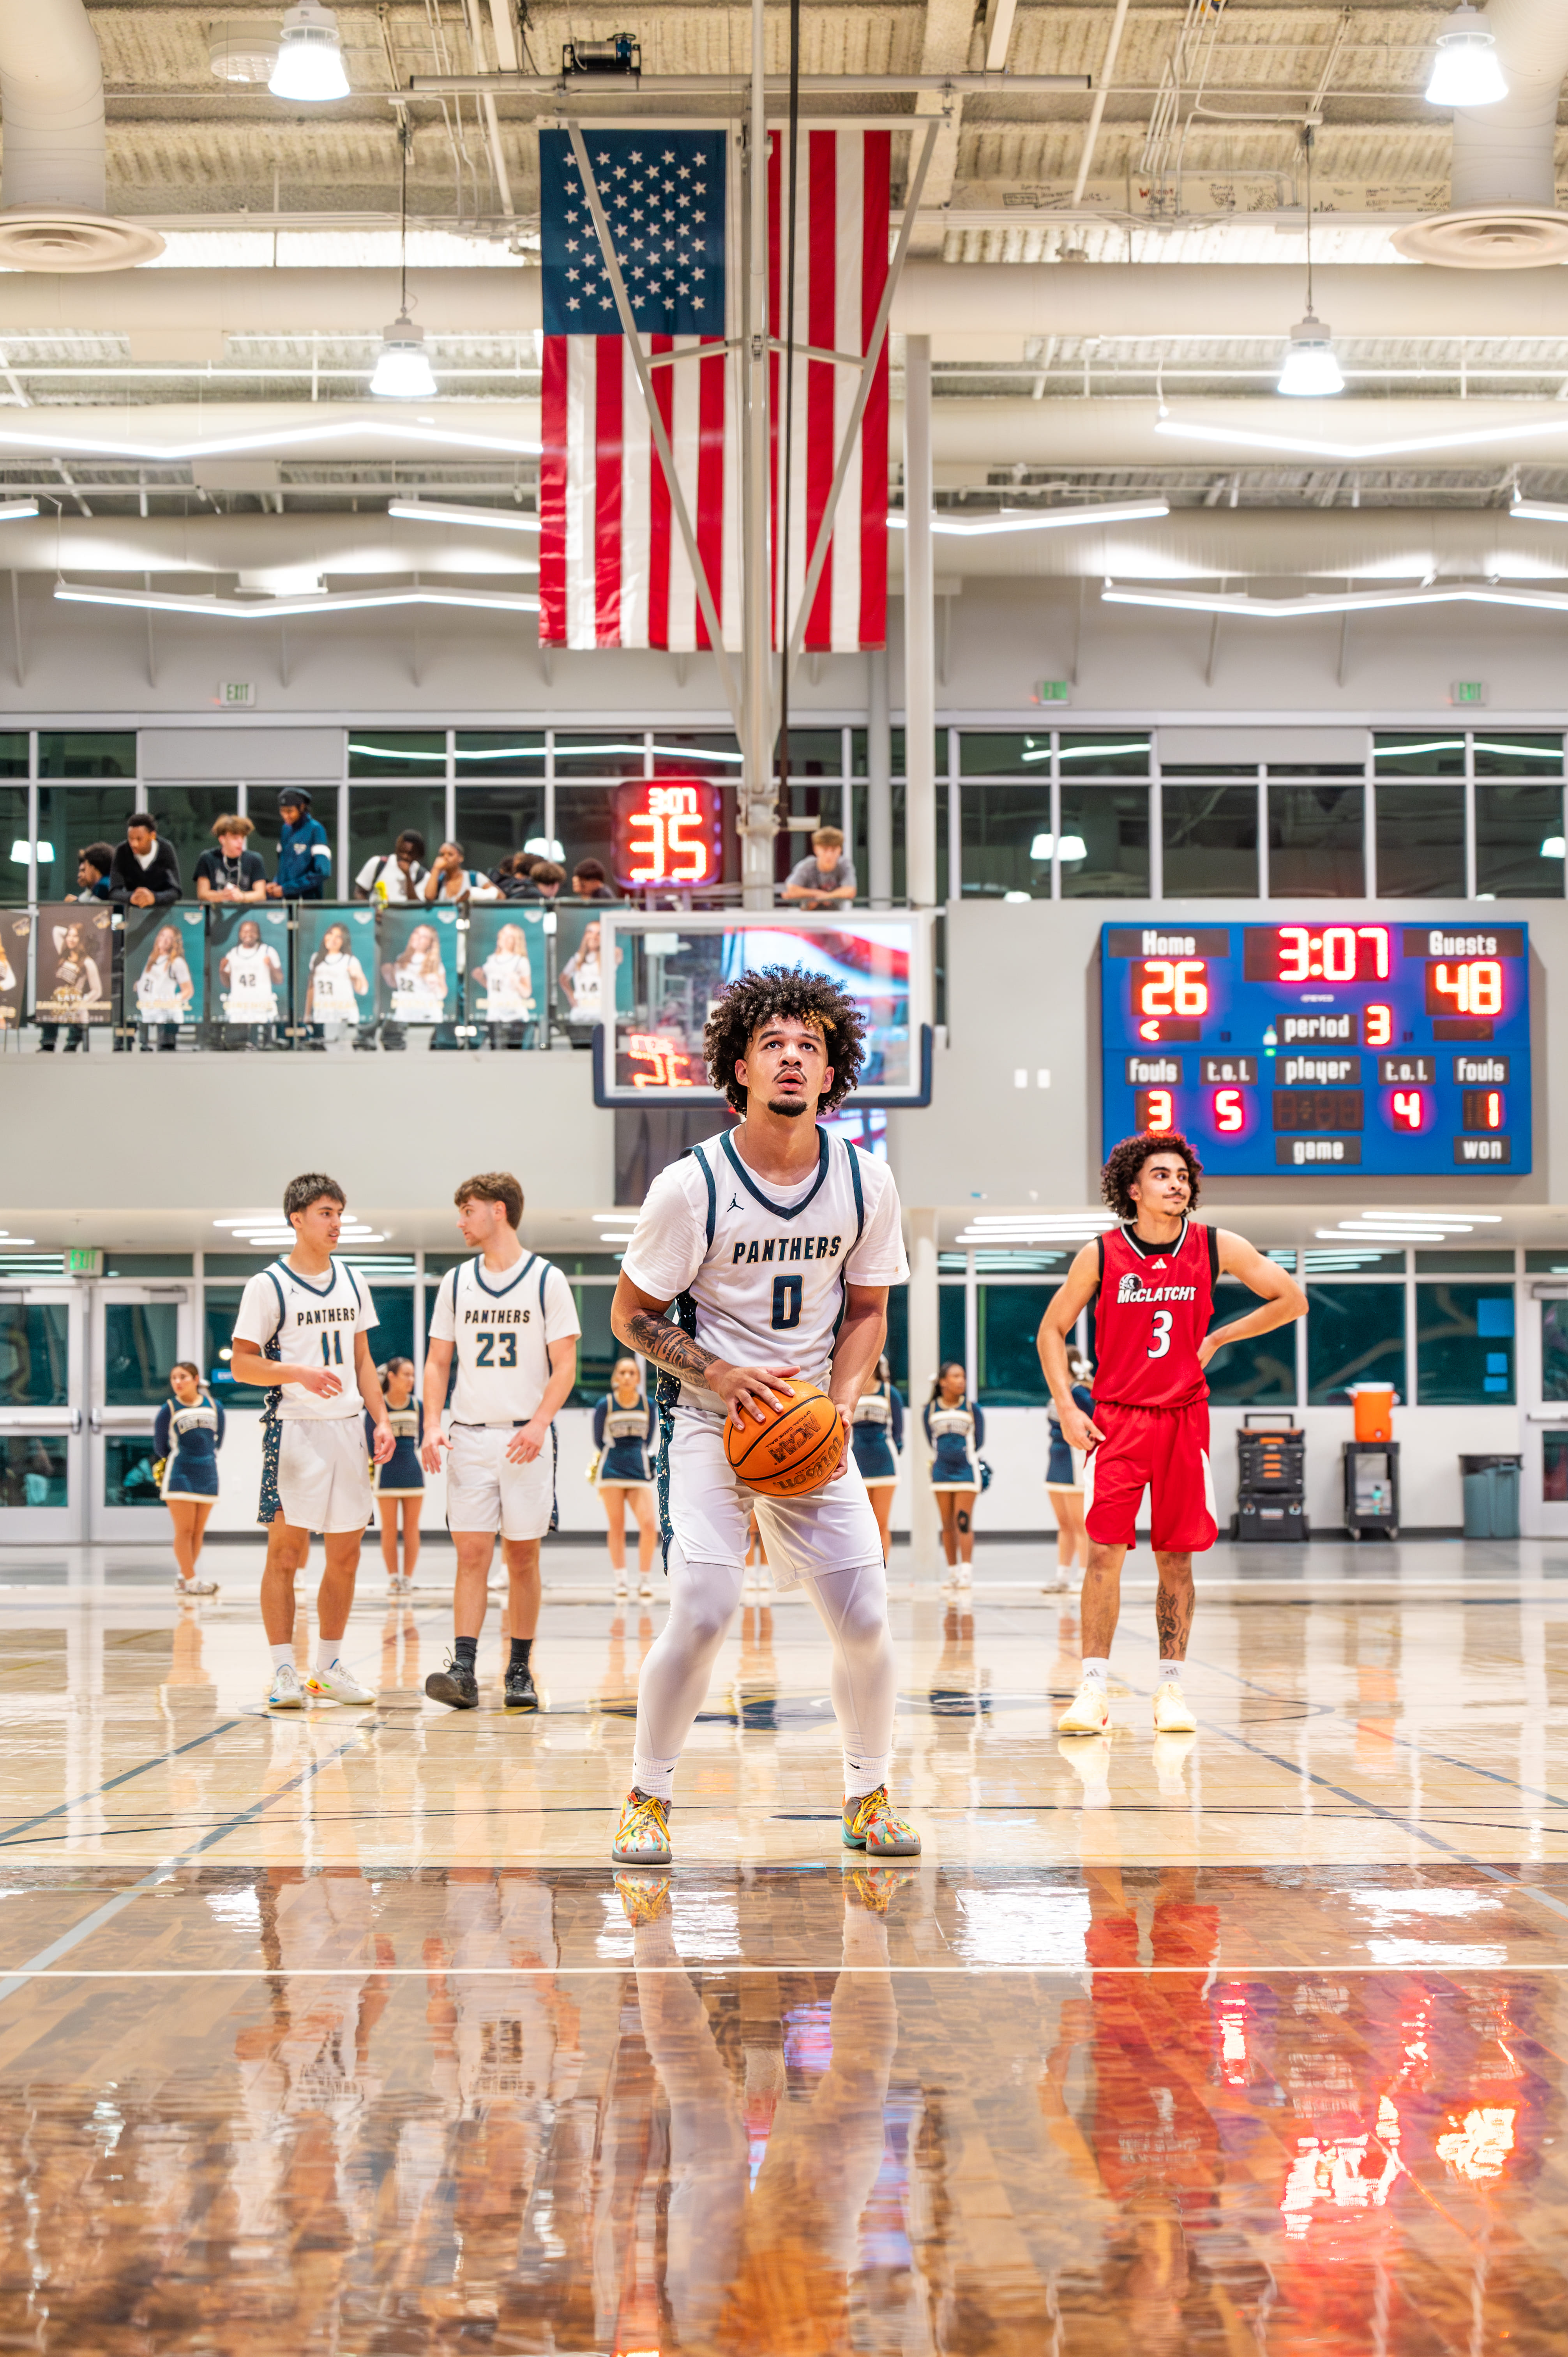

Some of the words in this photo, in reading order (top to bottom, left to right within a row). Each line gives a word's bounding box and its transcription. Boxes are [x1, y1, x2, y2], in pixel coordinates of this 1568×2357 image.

[226, 683, 249, 700] EXIT
[629, 814, 706, 879] 35
[1142, 930, 1196, 957] Home
[1278, 926, 1389, 981] 3:07
[1429, 930, 1497, 957] Guests
[239, 974, 256, 987] 42
[1141, 961, 1208, 1016] 26
[1435, 961, 1502, 1015] 48
[1284, 1016, 1349, 1042] period
[1366, 1004, 1391, 1046] 3
[1129, 1058, 1178, 1082] fouls
[1285, 1058, 1351, 1084] player
[1457, 1057, 1505, 1082] fouls
[1148, 1090, 1172, 1130] 3
[1215, 1090, 1243, 1131] 5
[1392, 1092, 1421, 1128] 4
[1488, 1092, 1499, 1127] 1
[1293, 1139, 1344, 1164] game
[1463, 1140, 1502, 1159] won
[70, 1249, 97, 1270] EXIT
[731, 1235, 842, 1265] PANTHERS
[770, 1273, 805, 1332] 0
[1116, 1286, 1197, 1304] McCLATCHY
[297, 1307, 356, 1326] PANTHERS
[465, 1309, 530, 1324] PANTHERS
[321, 1330, 344, 1366] 11
[1147, 1309, 1173, 1359] 3
[475, 1332, 517, 1368] 23
[765, 1438, 779, 1448] BALL
[768, 1413, 821, 1463] NCAA
[778, 1426, 793, 1440] GAME
[775, 1437, 843, 1490] Wilson
